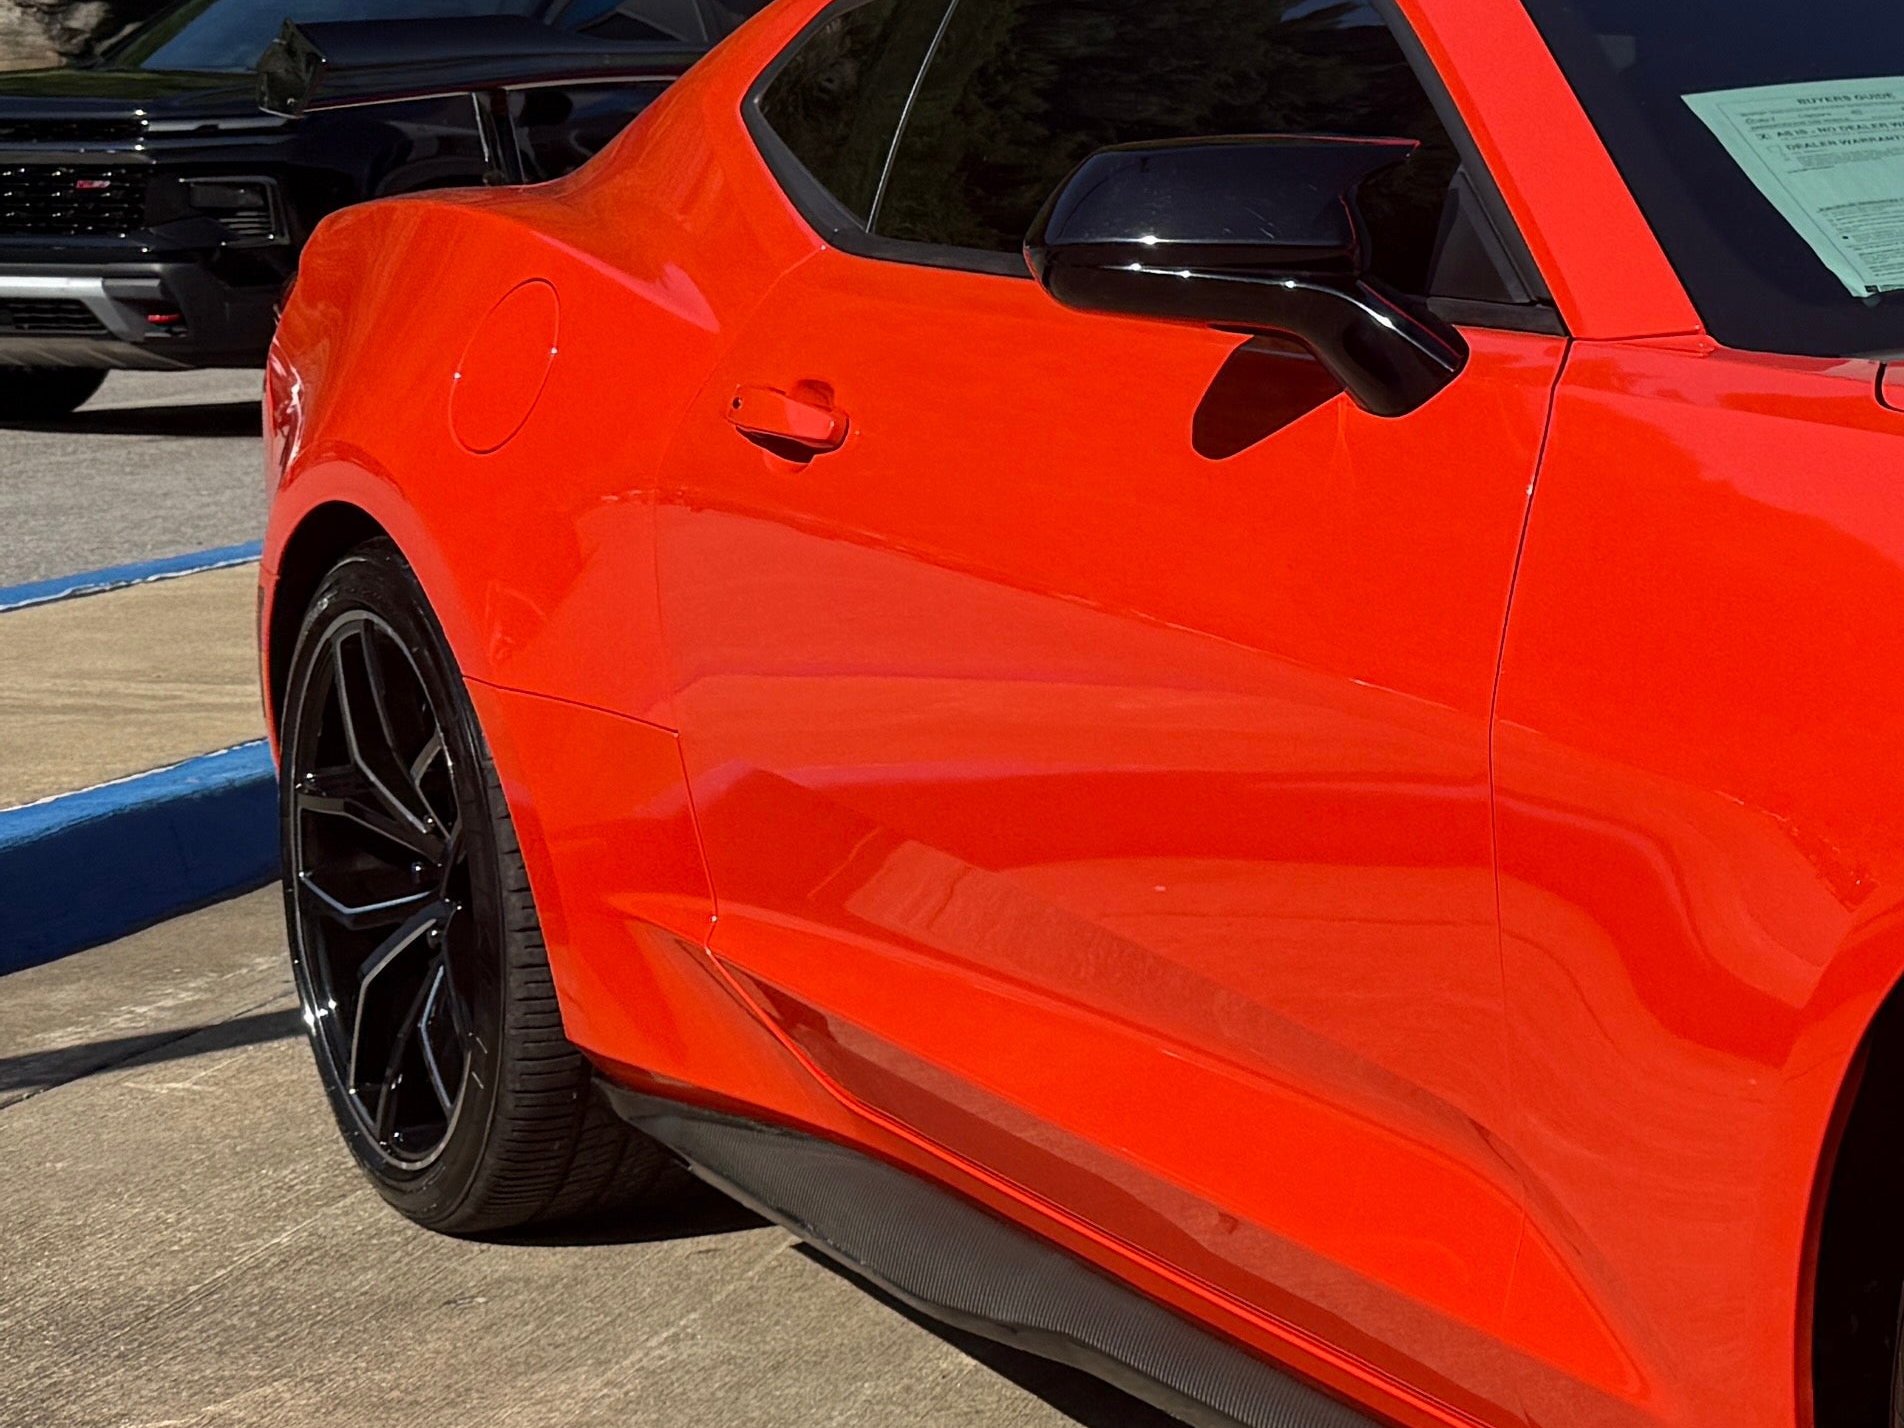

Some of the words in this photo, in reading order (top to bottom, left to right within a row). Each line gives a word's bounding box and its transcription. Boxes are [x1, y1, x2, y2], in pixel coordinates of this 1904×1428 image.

[1796, 94, 1852, 105] BUYERS
[1854, 91, 1896, 101] GUIDE
[1839, 122, 1888, 132] DEALER
[1785, 139, 1837, 151] DEALER
